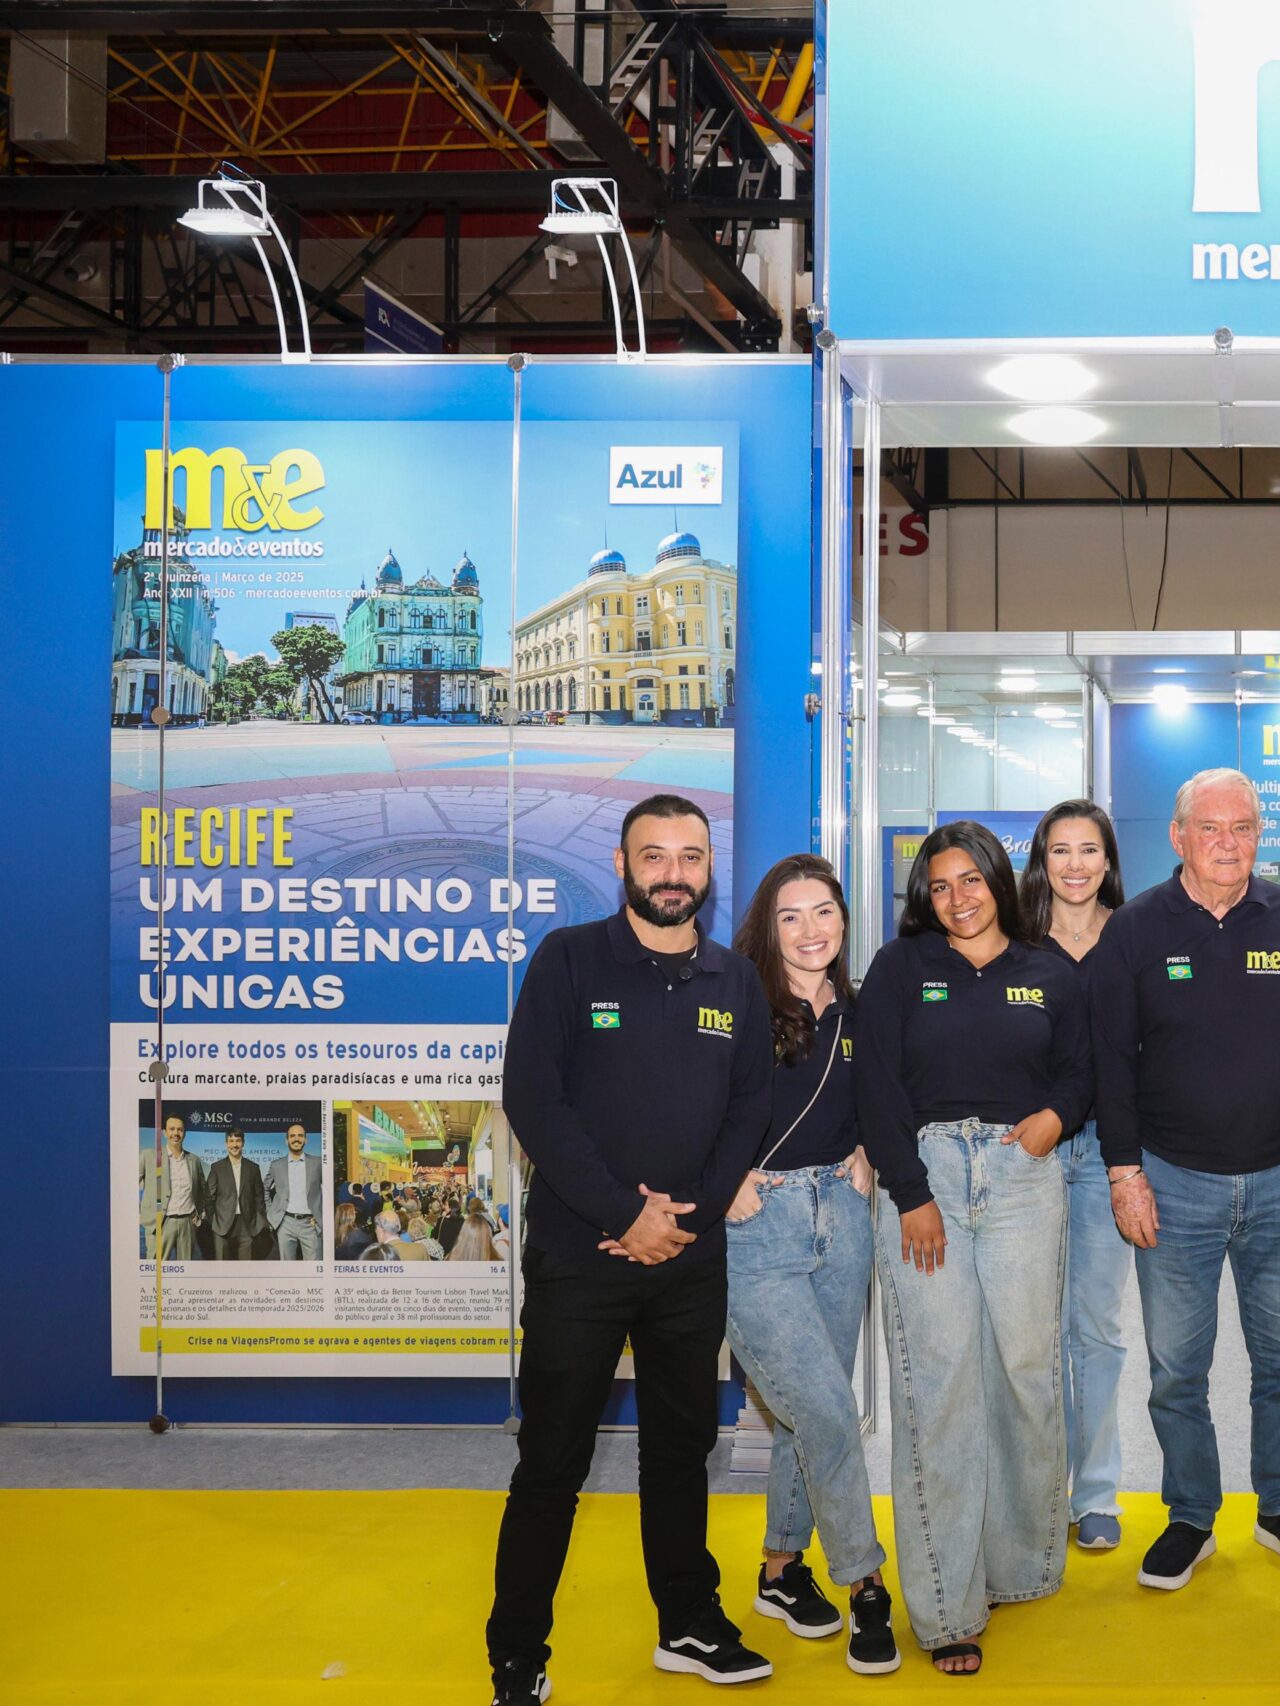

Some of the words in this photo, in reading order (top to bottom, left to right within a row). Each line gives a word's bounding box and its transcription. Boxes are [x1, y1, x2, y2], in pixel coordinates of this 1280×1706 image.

[616, 463, 683, 491] Azul
[145, 447, 325, 532] m&e
[144, 536, 324, 557] mercado&eventos
[222, 572, 254, 585] Março
[258, 572, 273, 582] de
[276, 572, 304, 583] 2025
[171, 589, 192, 599] XXII
[140, 807, 294, 867] RECIFE
[138, 878, 222, 912] UM
[241, 878, 472, 913] DESTINO
[491, 879, 557, 913] DE
[139, 916, 528, 963] EXPERIÊNCIAS
[139, 963, 345, 1010] ÚNICAS
[1007, 987, 1044, 1003] m&e
[591, 1002, 620, 1010] PRESS
[698, 1006, 734, 1032] m&e
[138, 1039, 219, 1063] Explore
[228, 1040, 286, 1059] todos
[295, 1043, 318, 1059] os
[327, 1041, 418, 1059] tesouros
[427, 1040, 450, 1059] da
[460, 1040, 505, 1064] capi
[139, 1071, 189, 1084] Cutura
[195, 1072, 261, 1084] marcante,
[267, 1072, 307, 1086] praias
[312, 1073, 395, 1087] paradisíacas
[402, 1075, 409, 1084] e
[415, 1075, 442, 1084] uma
[448, 1073, 472, 1084] rica
[479, 1074, 502, 1087] gas
[204, 1113, 233, 1123] MSC
[140, 1265, 185, 1273] CRUEIROS
[357, 1288, 378, 1296] edição
[188, 1336, 213, 1346] Crise
[217, 1337, 228, 1345] na
[232, 1336, 300, 1347] ViagensPromo
[304, 1337, 315, 1345] se
[319, 1337, 350, 1347] agrava
[363, 1337, 401, 1347] agentes
[405, 1336, 416, 1345] de
[420, 1336, 457, 1347] viagens
[461, 1336, 496, 1345] cobram
